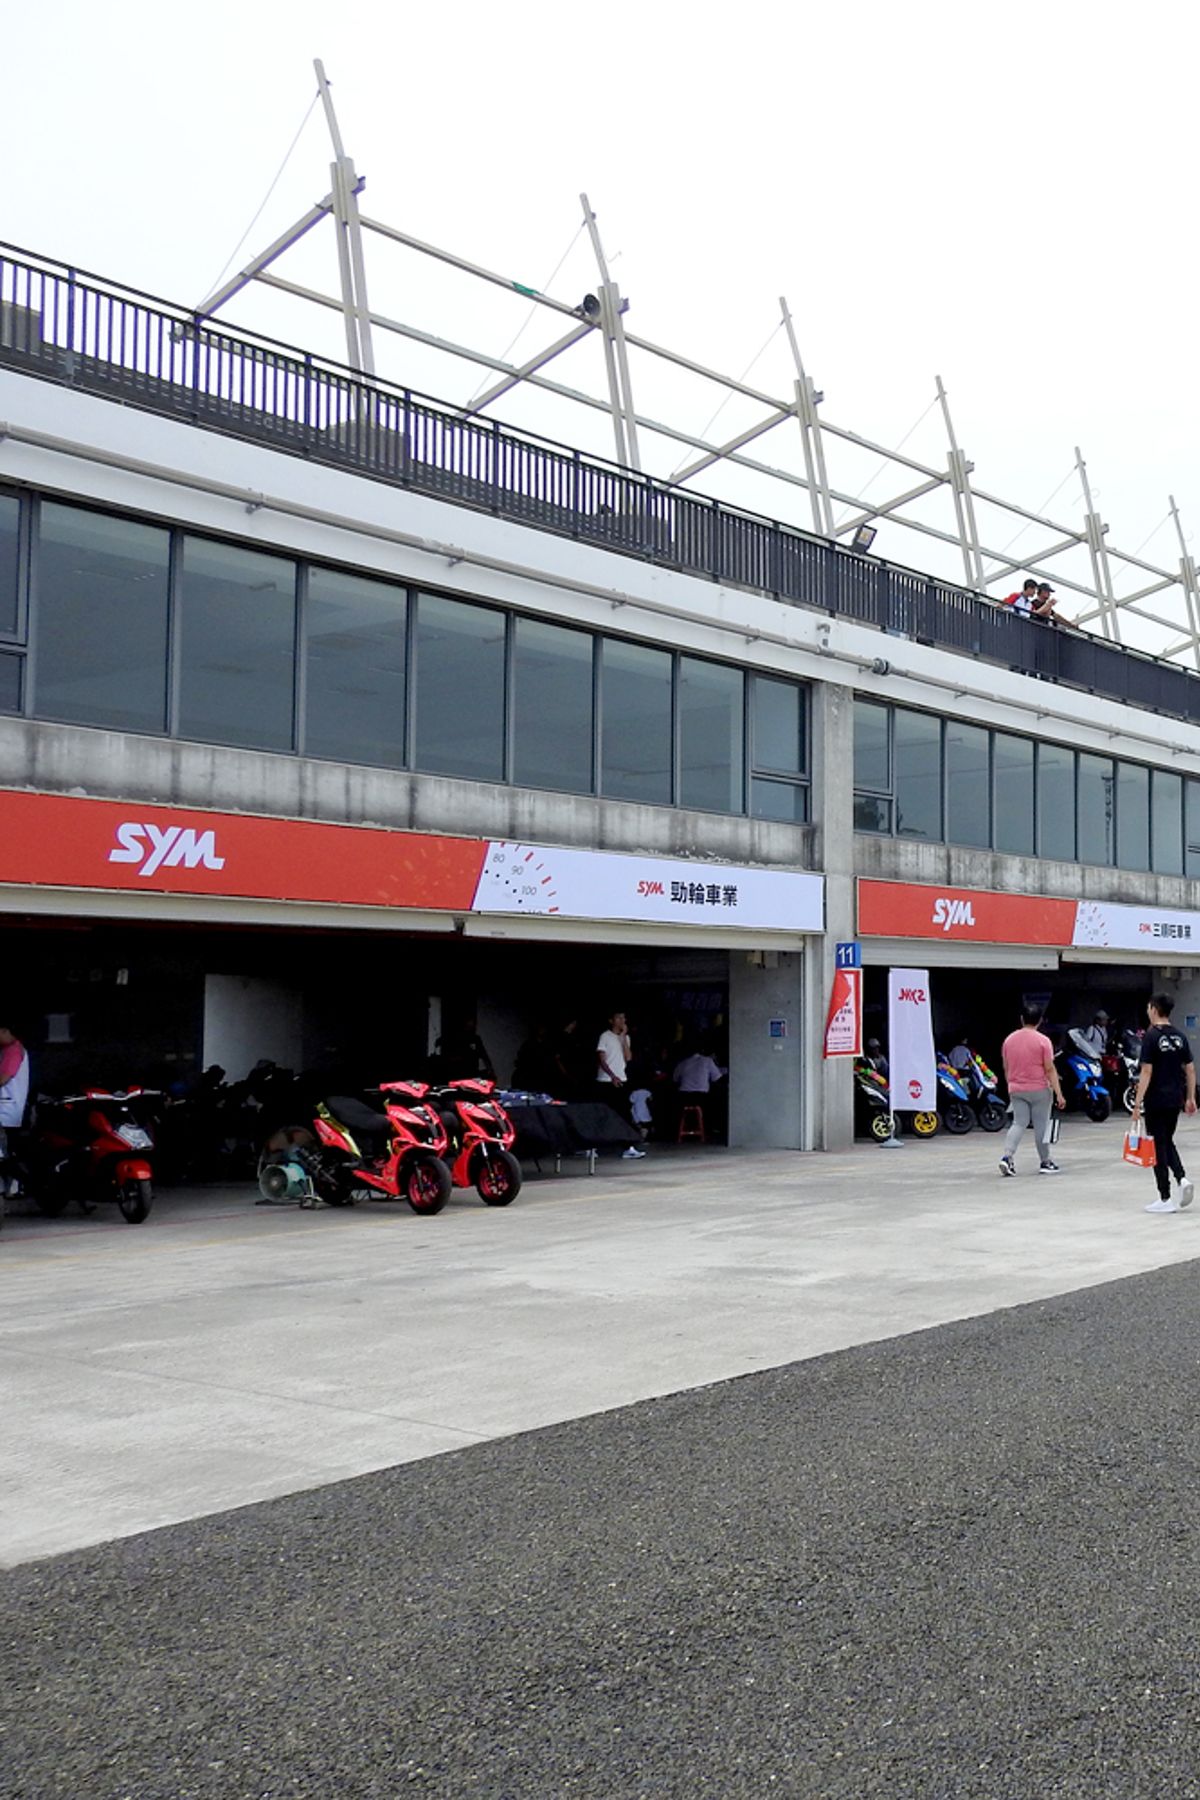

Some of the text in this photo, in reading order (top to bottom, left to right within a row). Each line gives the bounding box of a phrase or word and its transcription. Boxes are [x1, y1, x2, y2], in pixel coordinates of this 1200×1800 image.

[109, 822, 226, 876] SYM
[493, 853, 505, 863] 80
[511, 865, 524, 875] 90
[521, 886, 537, 896] 100
[637, 880, 738, 907] SYM 勁輪車業
[932, 898, 976, 932] SYM
[838, 946, 853, 964] 11
